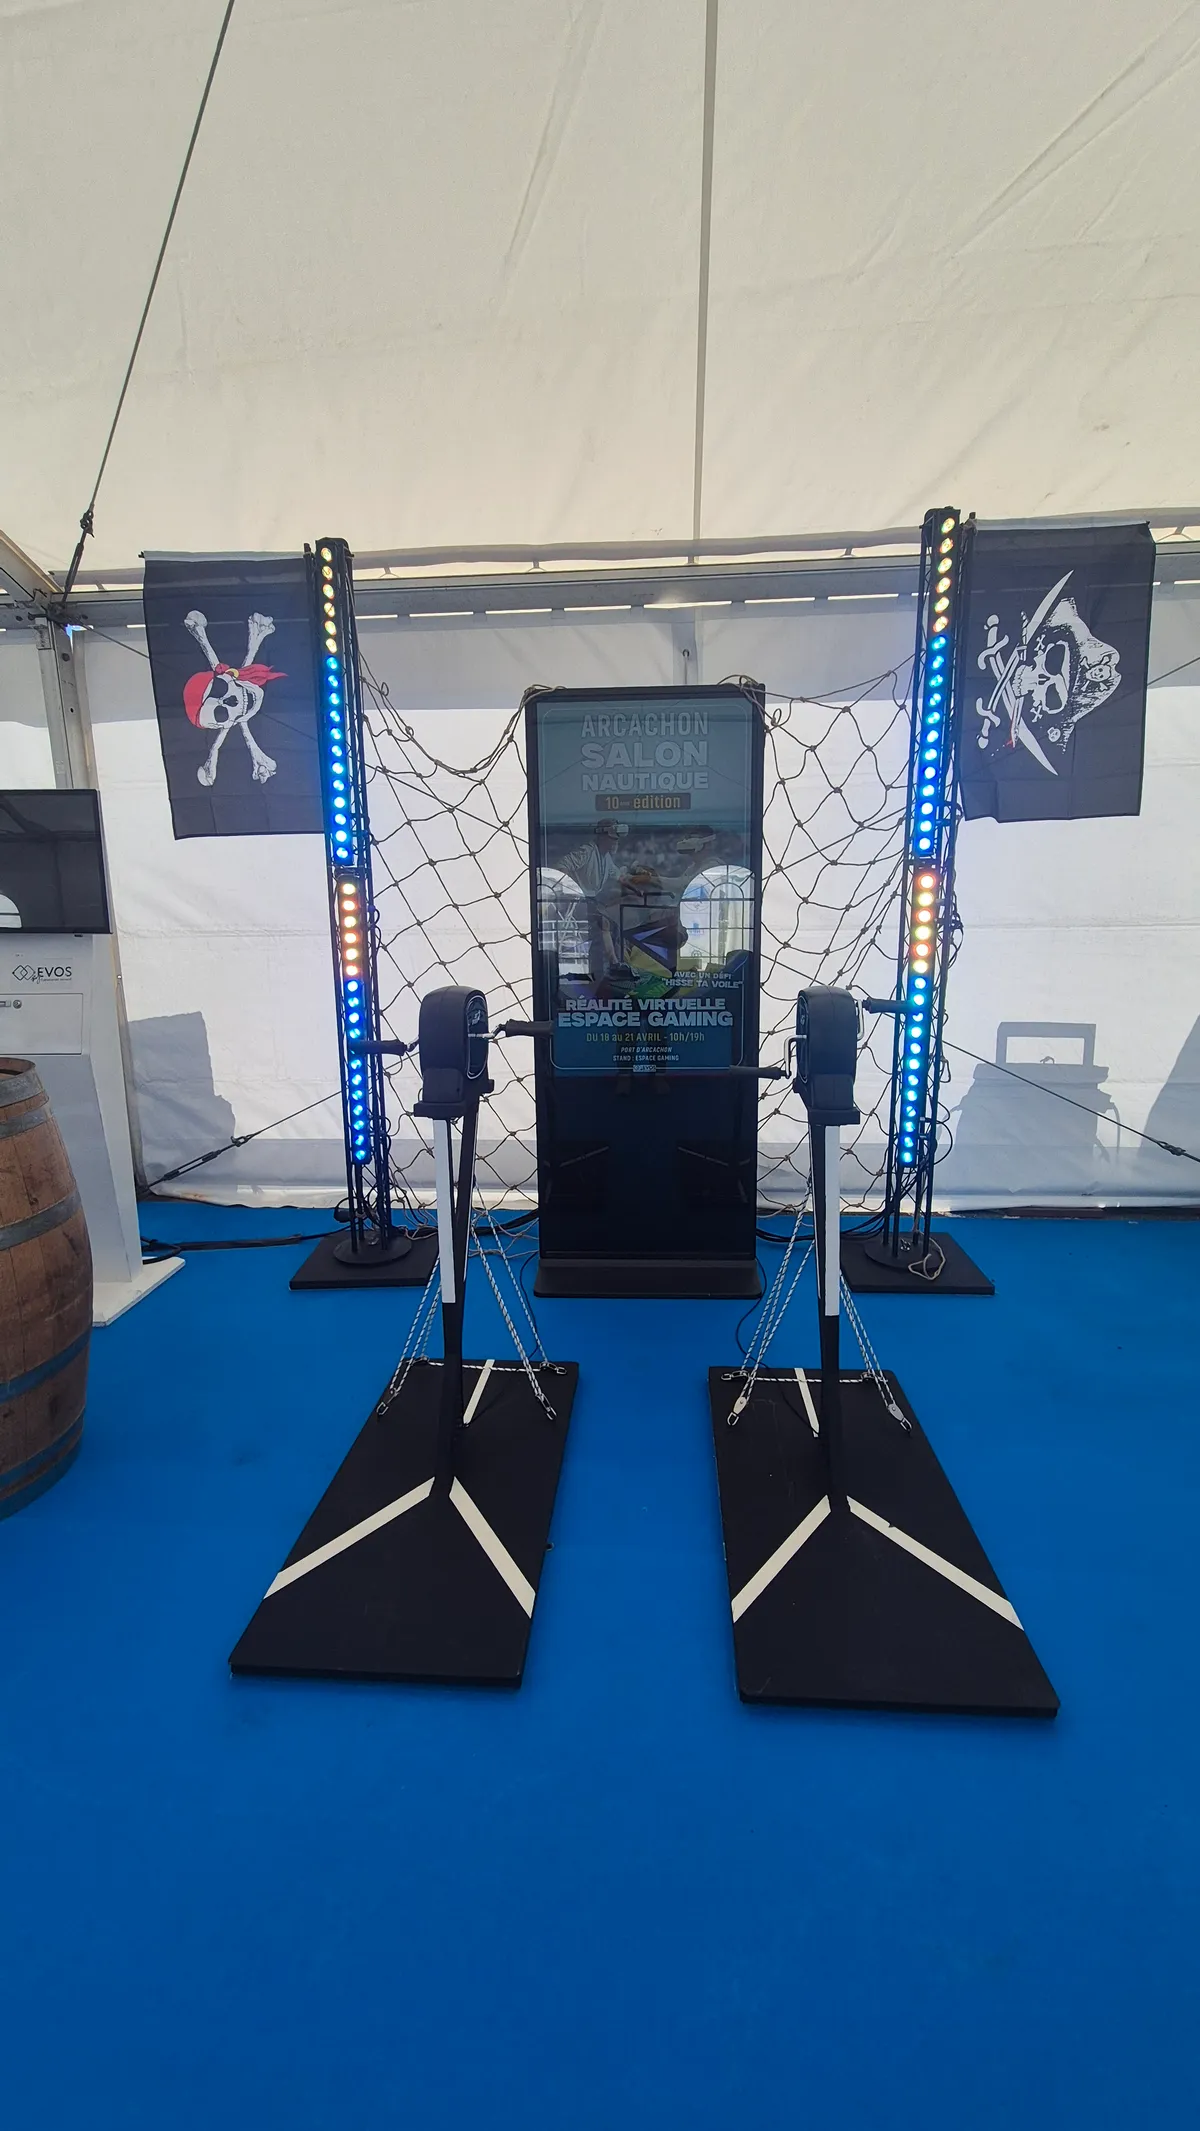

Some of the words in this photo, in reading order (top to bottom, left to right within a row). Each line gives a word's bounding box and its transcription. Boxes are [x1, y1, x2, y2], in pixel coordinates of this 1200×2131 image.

[581, 711, 708, 738] ARCACHON
[581, 741, 708, 768] SALON
[582, 772, 709, 791] NAUTIQUE
[633, 794, 681, 809] édition
[37, 966, 72, 978] EVOS
[713, 971, 732, 980] DÉFI
[696, 980, 709, 988] TA
[566, 995, 633, 1011] RÉALITÉ
[637, 998, 726, 1011] VIRTUELLE
[558, 1011, 641, 1027] ESPACE
[647, 1011, 734, 1027] GAMING
[586, 1032, 598, 1042] DU
[600, 1032, 610, 1042] 18
[611, 1032, 623, 1042] au
[625, 1032, 634, 1042] 21
[636, 1032, 661, 1042] AVRIL
[670, 1031, 705, 1042] 10h/19h
